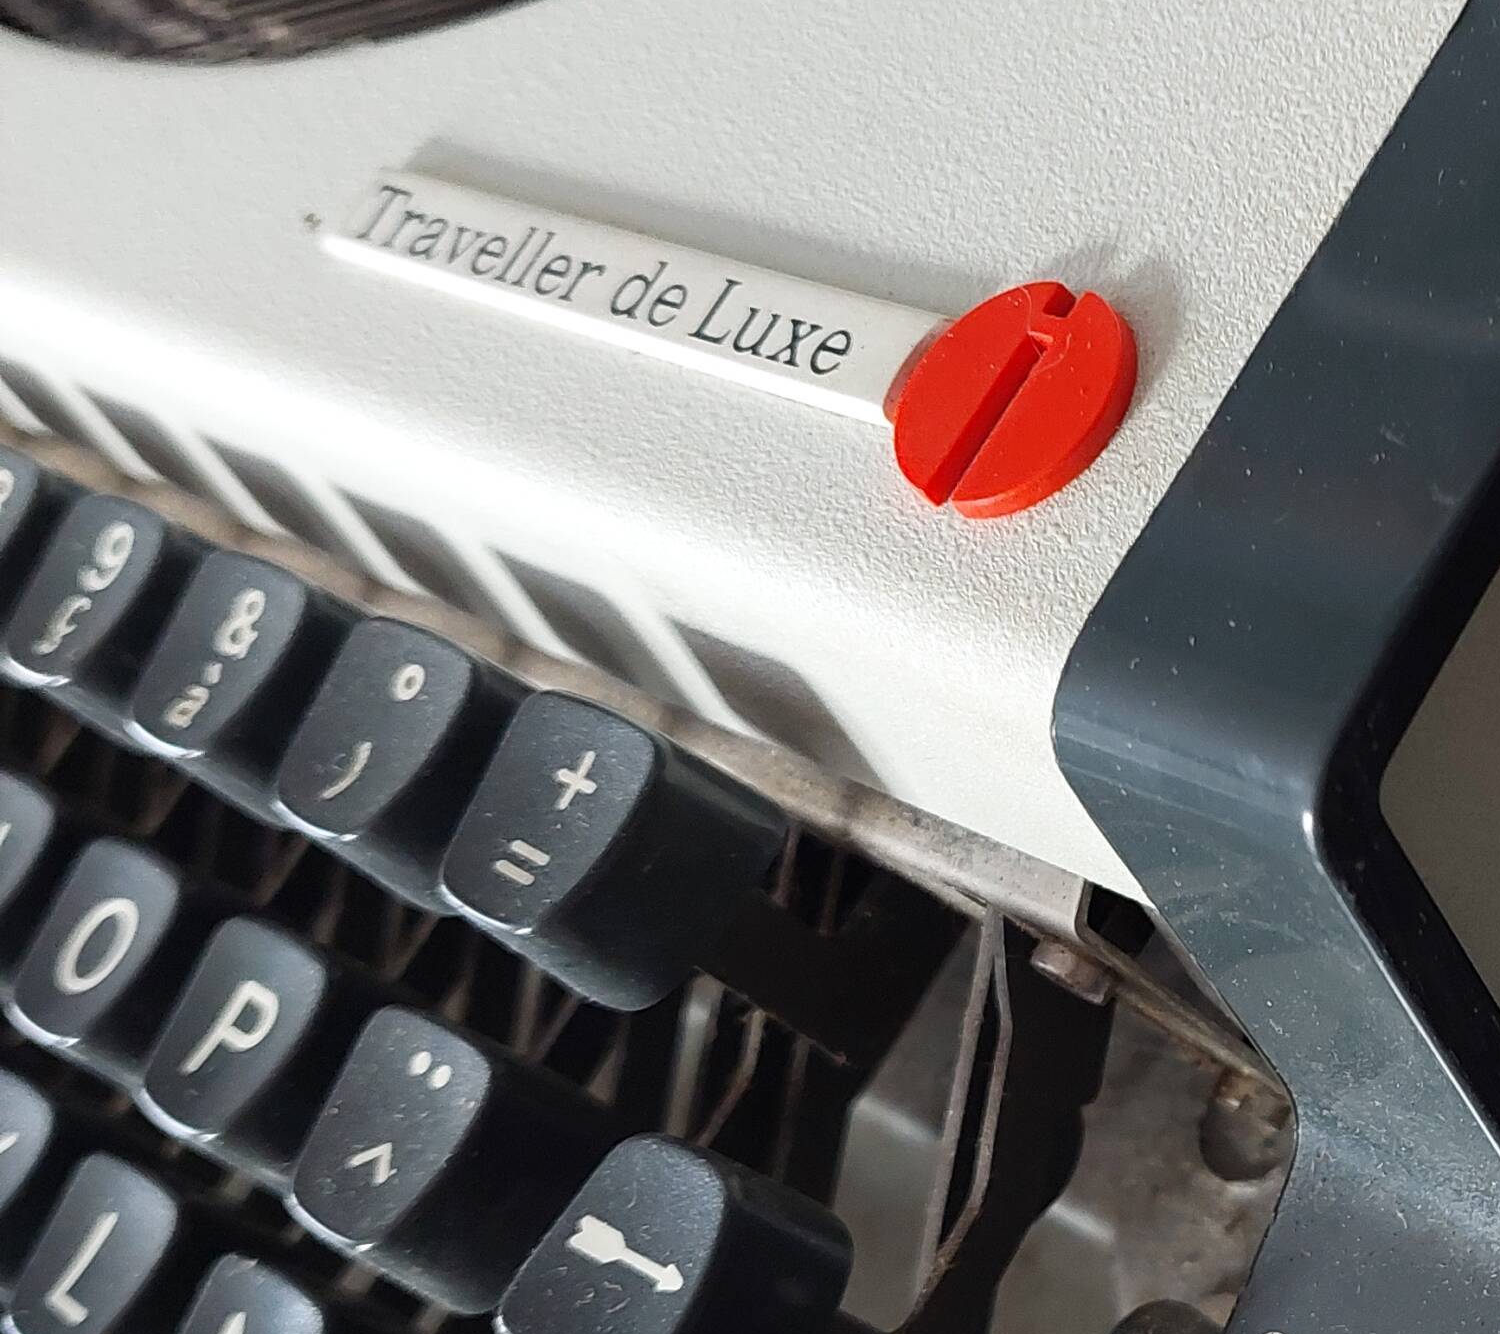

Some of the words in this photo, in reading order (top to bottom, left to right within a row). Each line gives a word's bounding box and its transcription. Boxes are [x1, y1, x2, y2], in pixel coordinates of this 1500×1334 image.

[356, 184, 605, 304] Traveller
[611, 260, 689, 327] de
[689, 278, 852, 376] Luxe
[77, 520, 135, 592] 9
[553, 749, 598, 812] +
[493, 838, 553, 887] =
[178, 978, 281, 1076] P
[44, 1209, 120, 1326] L
